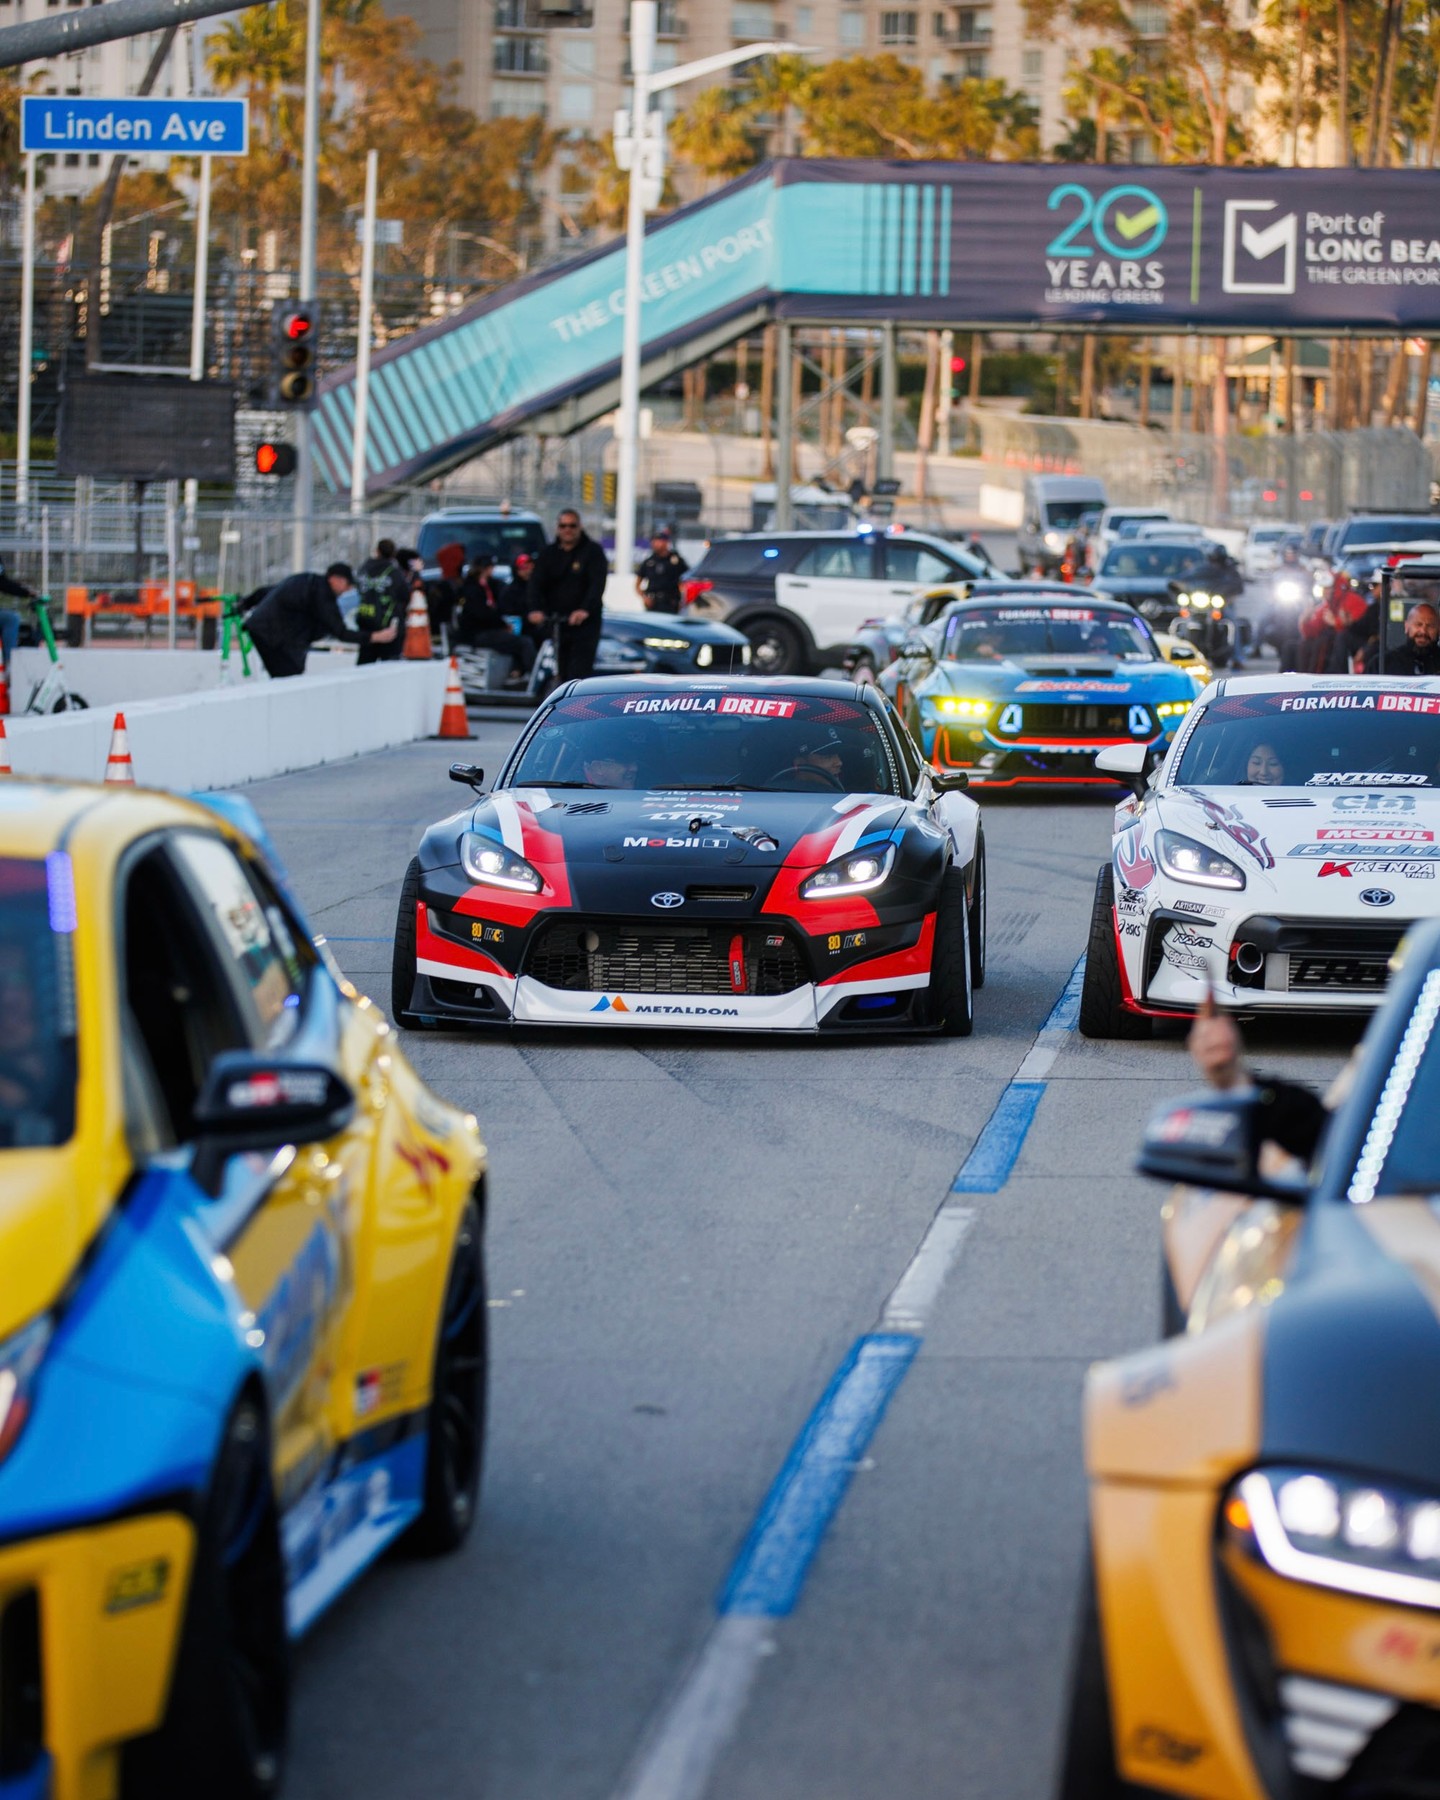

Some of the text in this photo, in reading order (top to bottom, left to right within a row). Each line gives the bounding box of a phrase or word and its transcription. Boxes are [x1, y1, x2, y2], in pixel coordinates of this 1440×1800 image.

[44, 111, 227, 142] Linden Ave
[1046, 183, 1169, 260] 20
[1306, 211, 1386, 239] Port of
[1305, 238, 1383, 263] LONG
[550, 216, 774, 343] THE GEEN PORT
[1045, 260, 1165, 289] YEARS
[1305, 265, 1440, 286] THE GREEN POR
[1111, 289, 1165, 305] GREEN
[998, 609, 1092, 620] FORMULA DRIFT
[623, 698, 792, 716] FORMULA DRIFT
[1280, 696, 1375, 711] FORMULA
[1309, 772, 1429, 784] ENTICED
[1322, 829, 1428, 840] MOTUL
[623, 837, 699, 848] Mobil
[1286, 843, 1440, 856] GRedd
[1353, 861, 1435, 873] KENDA
[1404, 871, 1435, 879] TIRES
[1174, 900, 1204, 913] ARTISAN
[1125, 923, 1141, 937] asics
[828, 934, 841, 950] 80
[1169, 950, 1207, 967] sparco
[635, 1005, 739, 1016] METALDOM
